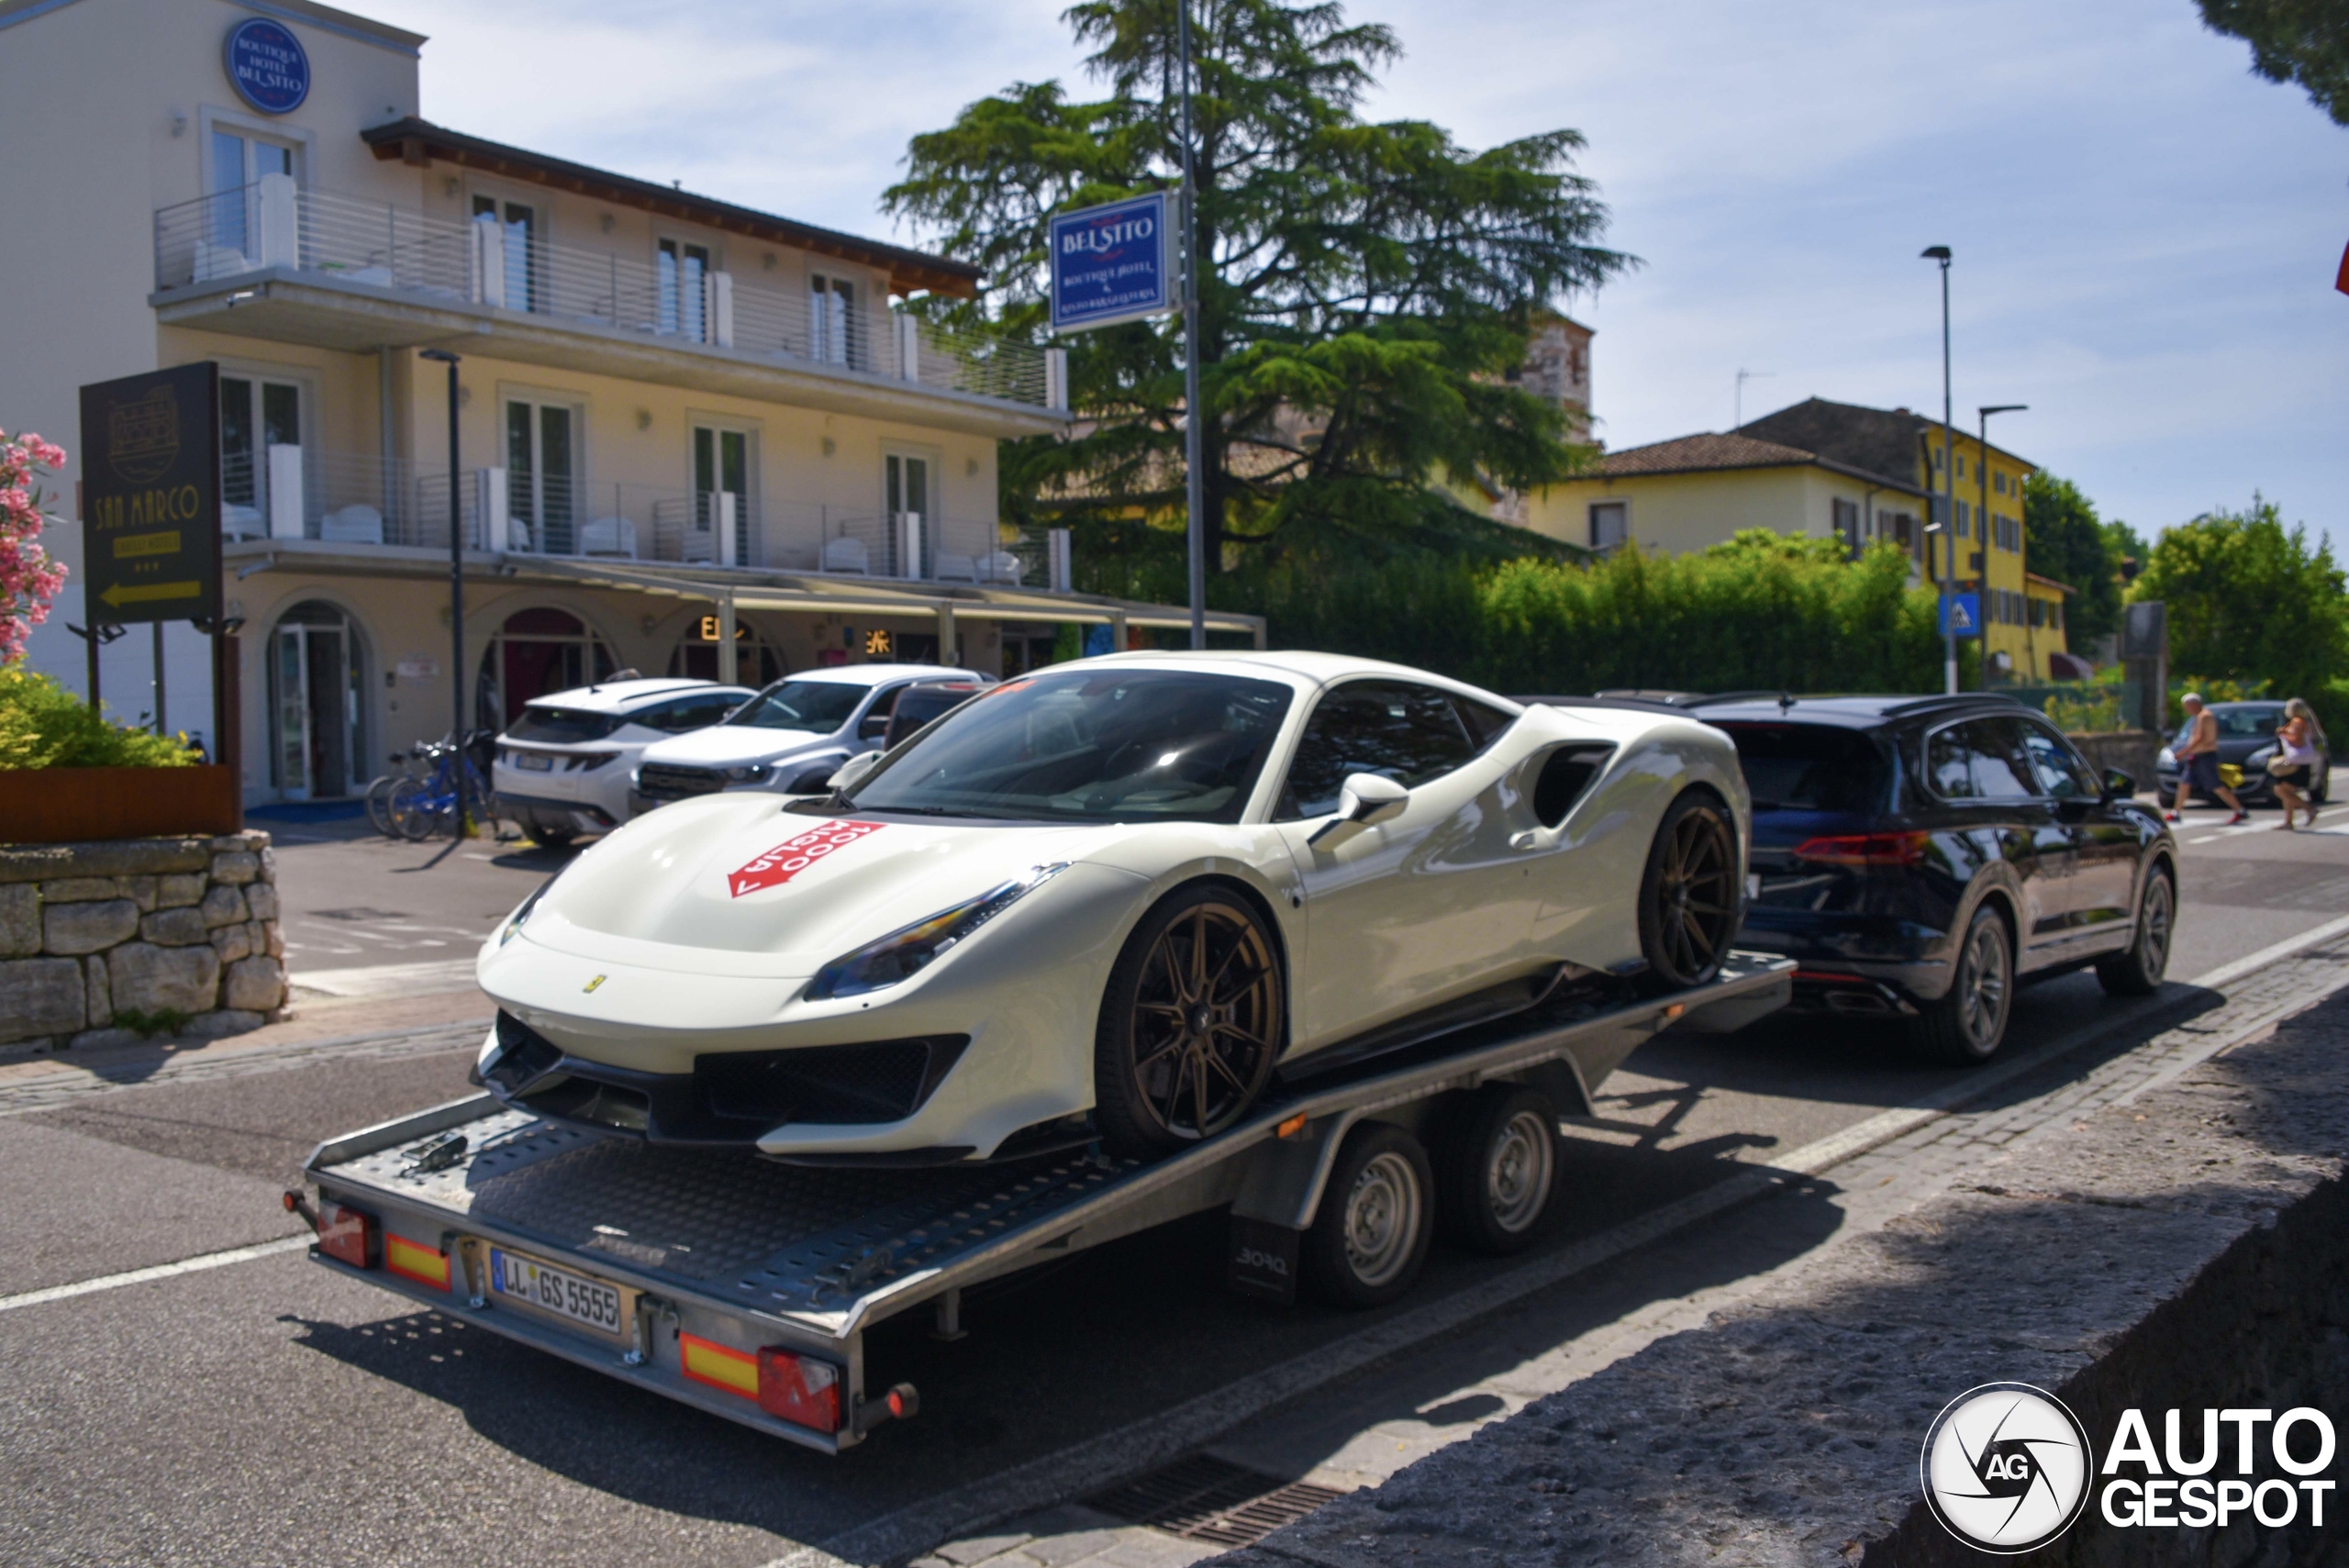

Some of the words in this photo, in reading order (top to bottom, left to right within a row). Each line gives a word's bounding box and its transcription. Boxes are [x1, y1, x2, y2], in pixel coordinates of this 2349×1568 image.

[95, 495, 124, 530] SAN
[131, 484, 199, 526] MARCO
[744, 820, 851, 873] MIGLIA
[504, 1258, 527, 1296] LL
[540, 1271, 563, 1308] GS
[567, 1281, 618, 1327] 5555
